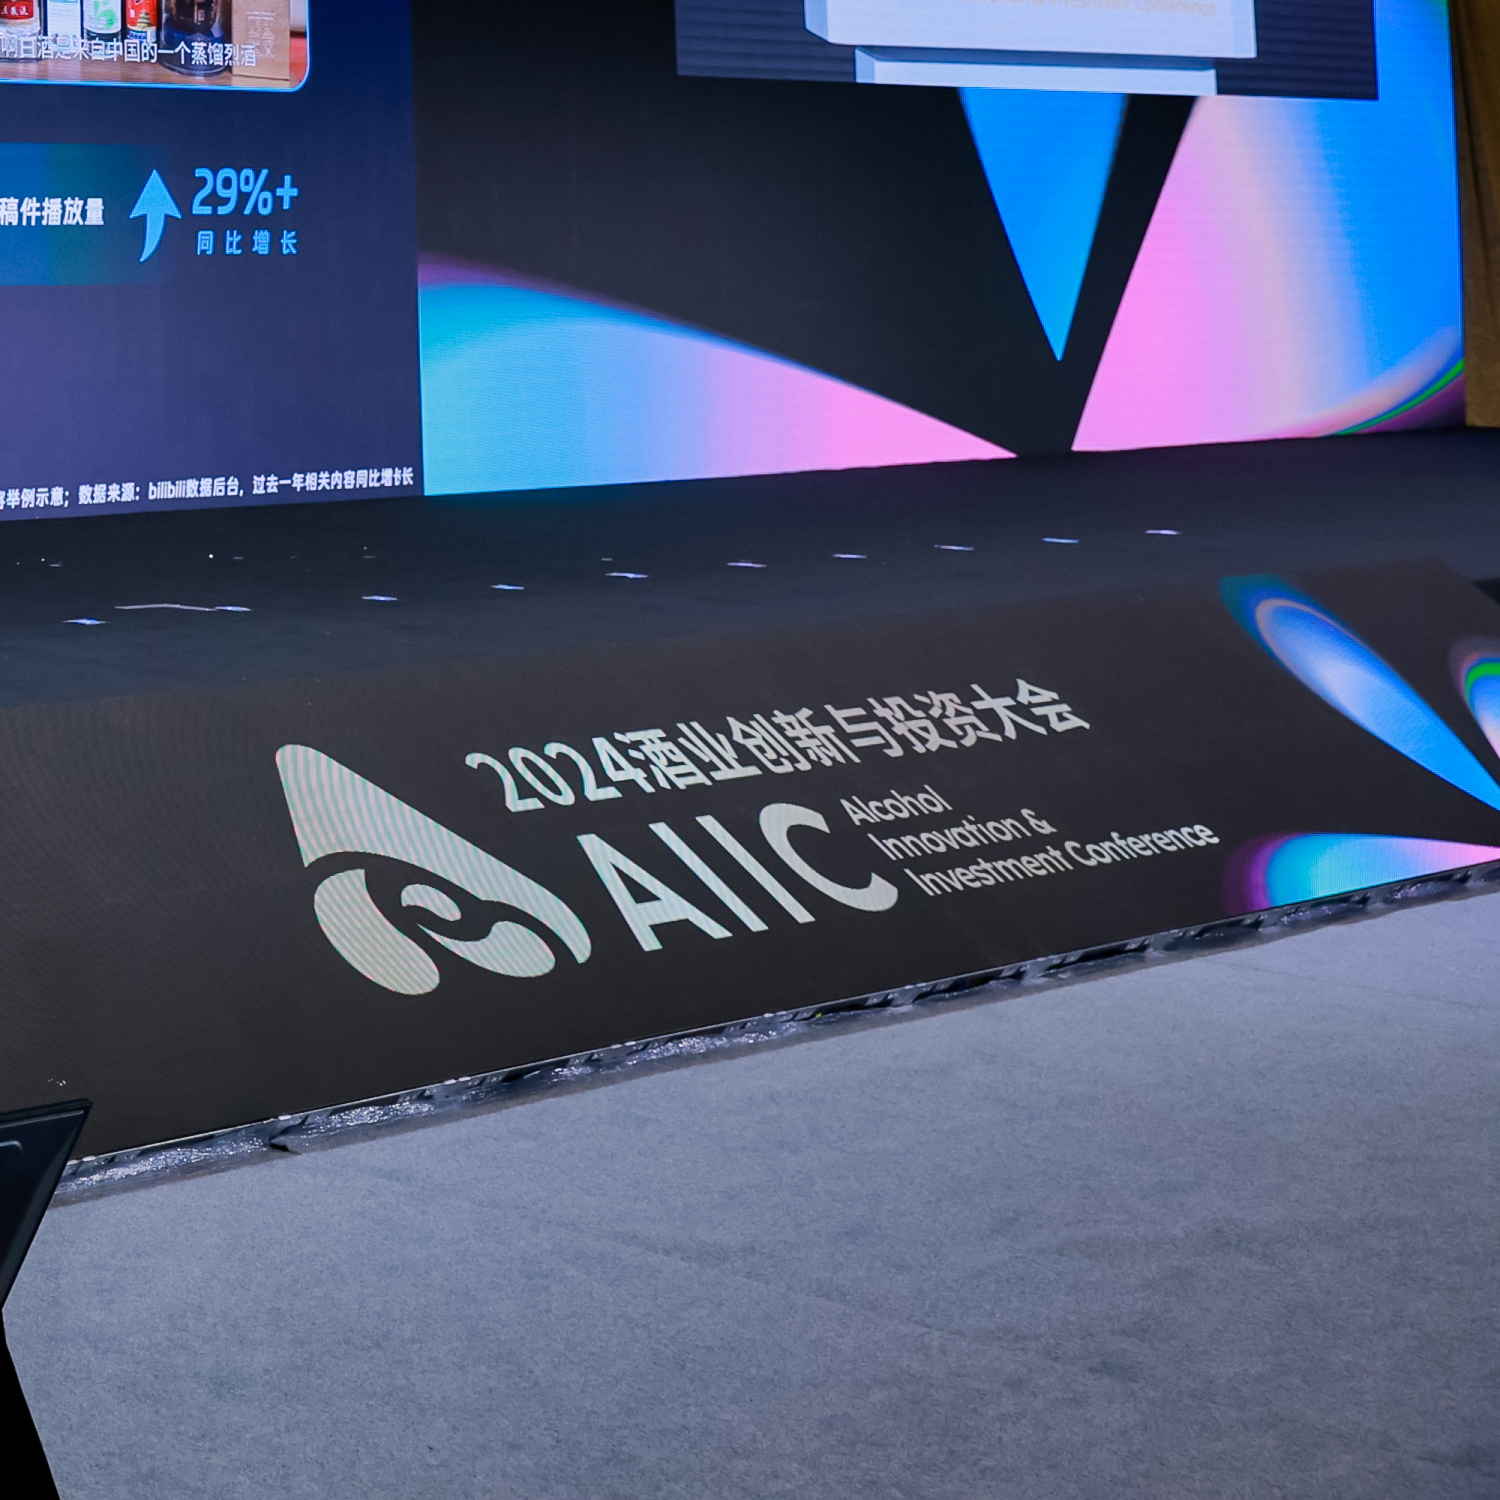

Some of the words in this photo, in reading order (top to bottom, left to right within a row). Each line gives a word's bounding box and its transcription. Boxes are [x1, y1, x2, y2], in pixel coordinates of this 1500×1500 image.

[191, 167, 300, 217] 29%+
[196, 229, 299, 256] 同比增长
[463, 677, 1091, 814] 2024酒业创新与投资大会
[839, 784, 954, 826] Alcohol
[867, 814, 1032, 861] Innovation
[1020, 807, 1058, 837] &
[903, 844, 1075, 897] Investment
[1064, 822, 1220, 868] Conference
[575, 801, 899, 952] AIIC
